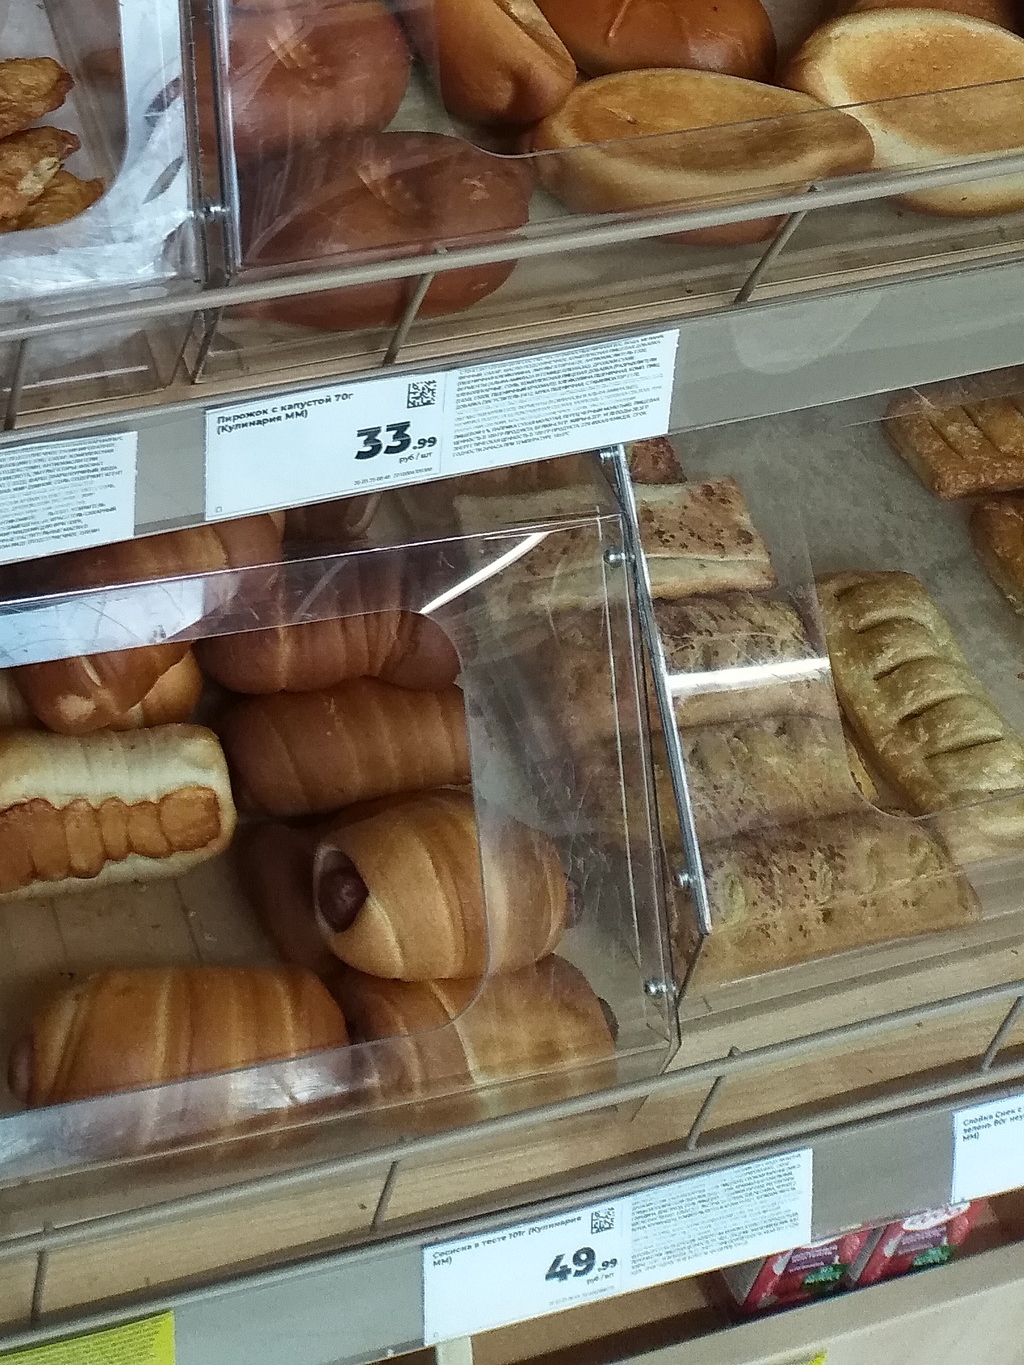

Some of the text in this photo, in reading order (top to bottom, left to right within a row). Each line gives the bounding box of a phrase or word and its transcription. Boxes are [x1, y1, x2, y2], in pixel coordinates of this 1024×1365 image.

[217, 407, 268, 424] Пирожок
[280, 395, 332, 411] капустой
[334, 393, 354, 402] 70г
[217, 409, 309, 435] (Кулинария ММ)
[399, 454, 415, 464] руб
[432, 1243, 472, 1259] Сосиска
[482, 1235, 507, 1247] тесте
[528, 1216, 582, 1235] (Кулинария
[433, 1255, 452, 1267] ММ)
